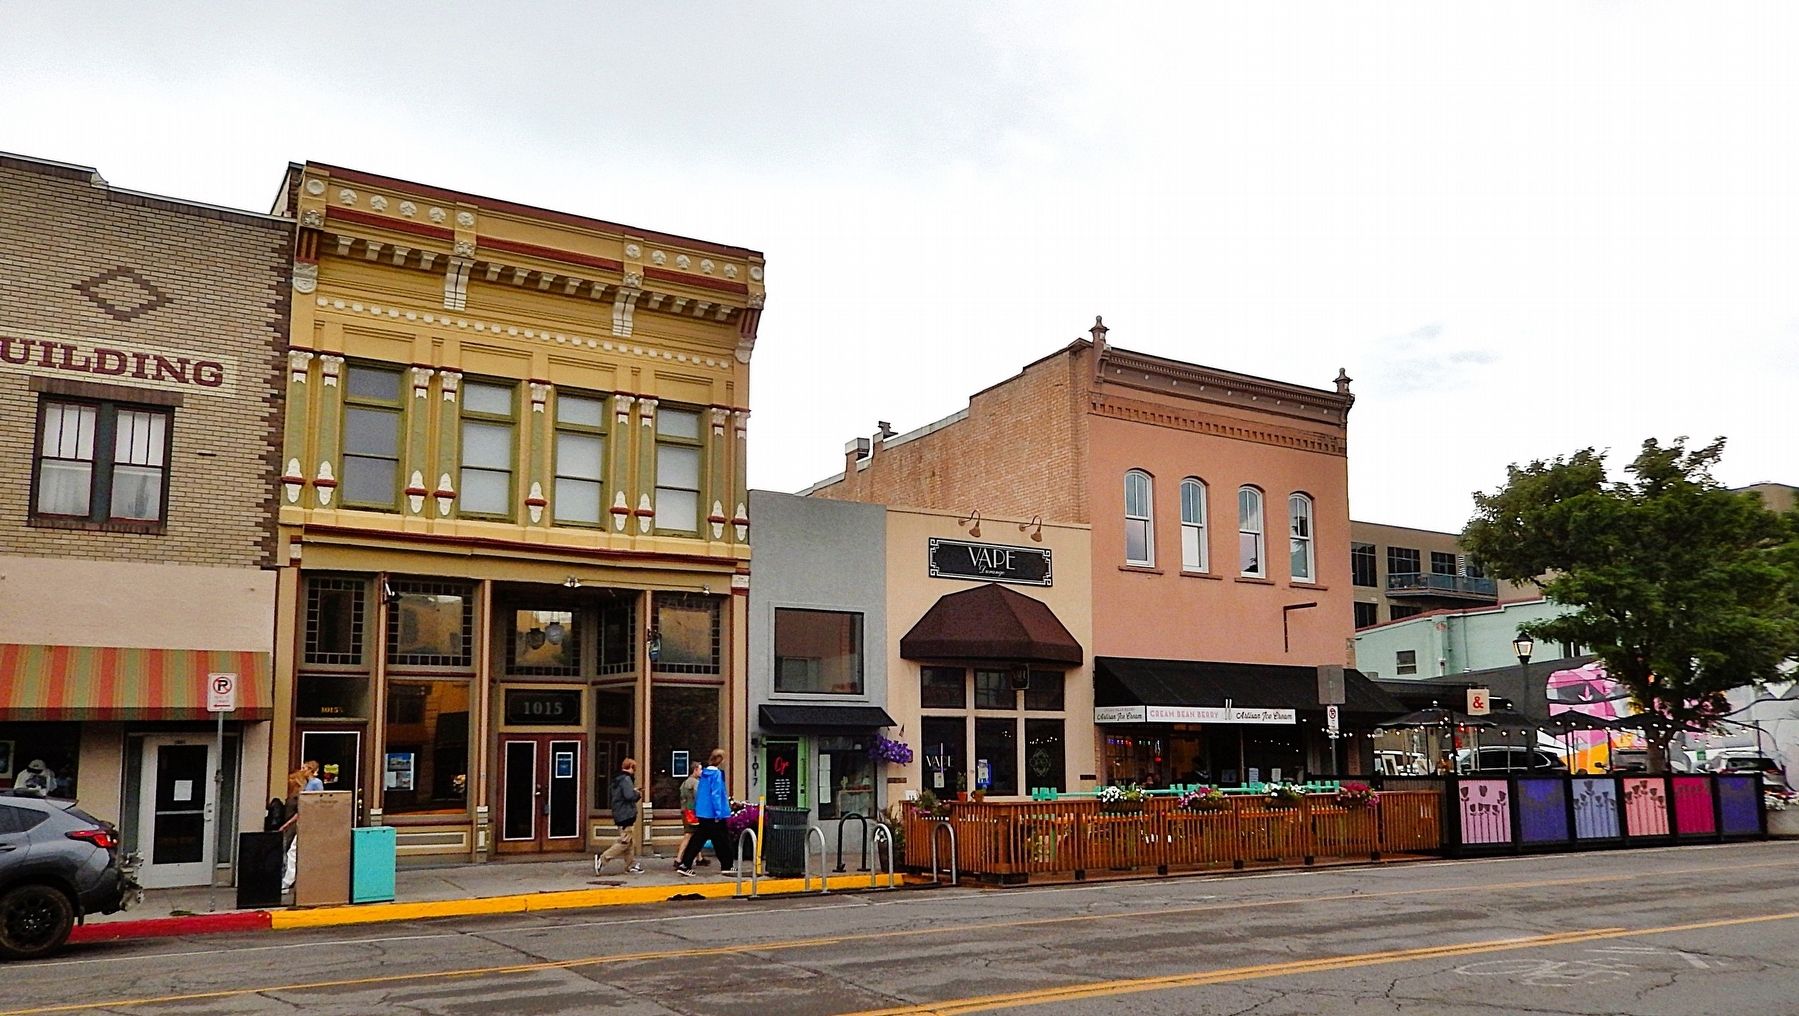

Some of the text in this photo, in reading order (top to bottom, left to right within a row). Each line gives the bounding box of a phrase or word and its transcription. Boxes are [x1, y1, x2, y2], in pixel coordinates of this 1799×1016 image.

[968, 546, 1017, 570] VAPE
[524, 701, 563, 715] 1015
[1150, 710, 1219, 719] CREAM BEAN BERRY
[1236, 712, 1261, 720] Artisan
[1273, 712, 1293, 720] Cream
[751, 755, 760, 787] 1017
